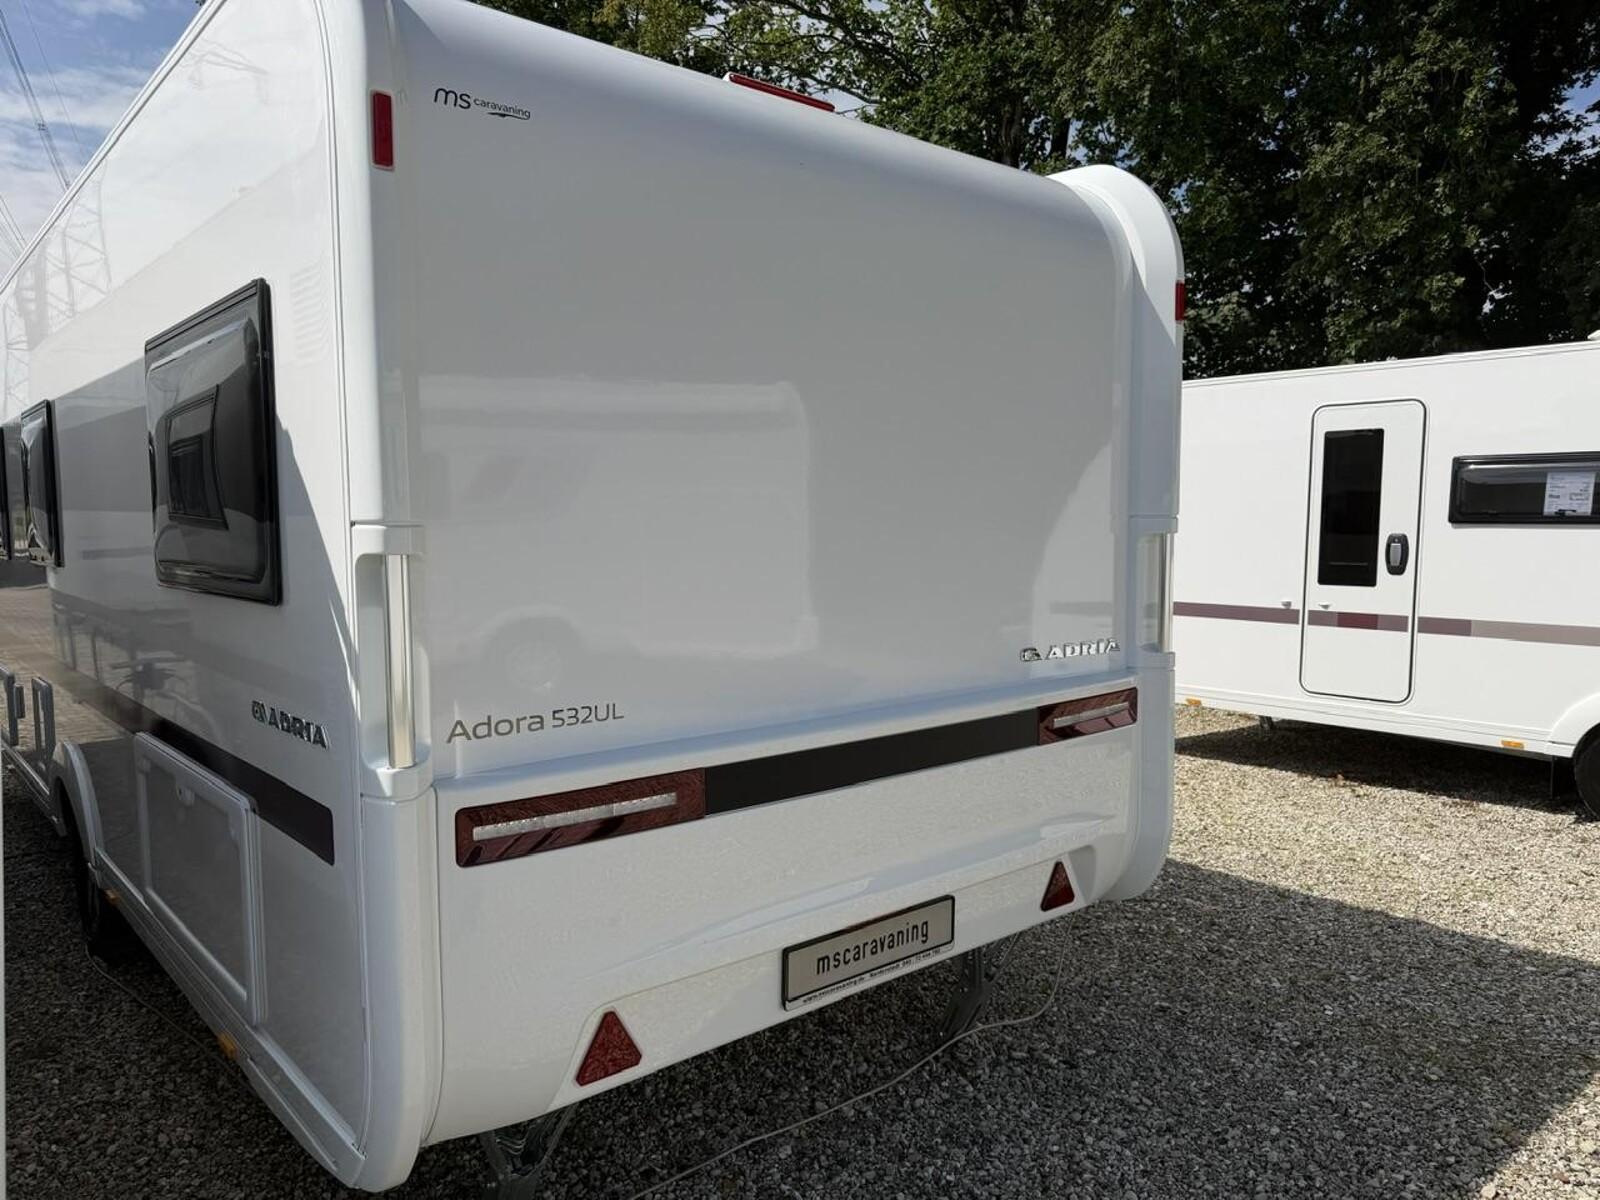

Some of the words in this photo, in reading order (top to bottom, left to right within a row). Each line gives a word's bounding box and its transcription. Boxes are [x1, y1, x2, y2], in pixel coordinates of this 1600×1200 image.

[434, 87, 471, 110] ms
[473, 98, 531, 120] caravaning
[1045, 637, 1120, 661] ADRIA
[268, 706, 329, 750] ADRIA
[446, 714, 545, 744] Adora
[552, 702, 625, 728] 532UL
[816, 920, 929, 976] mscaravaning
